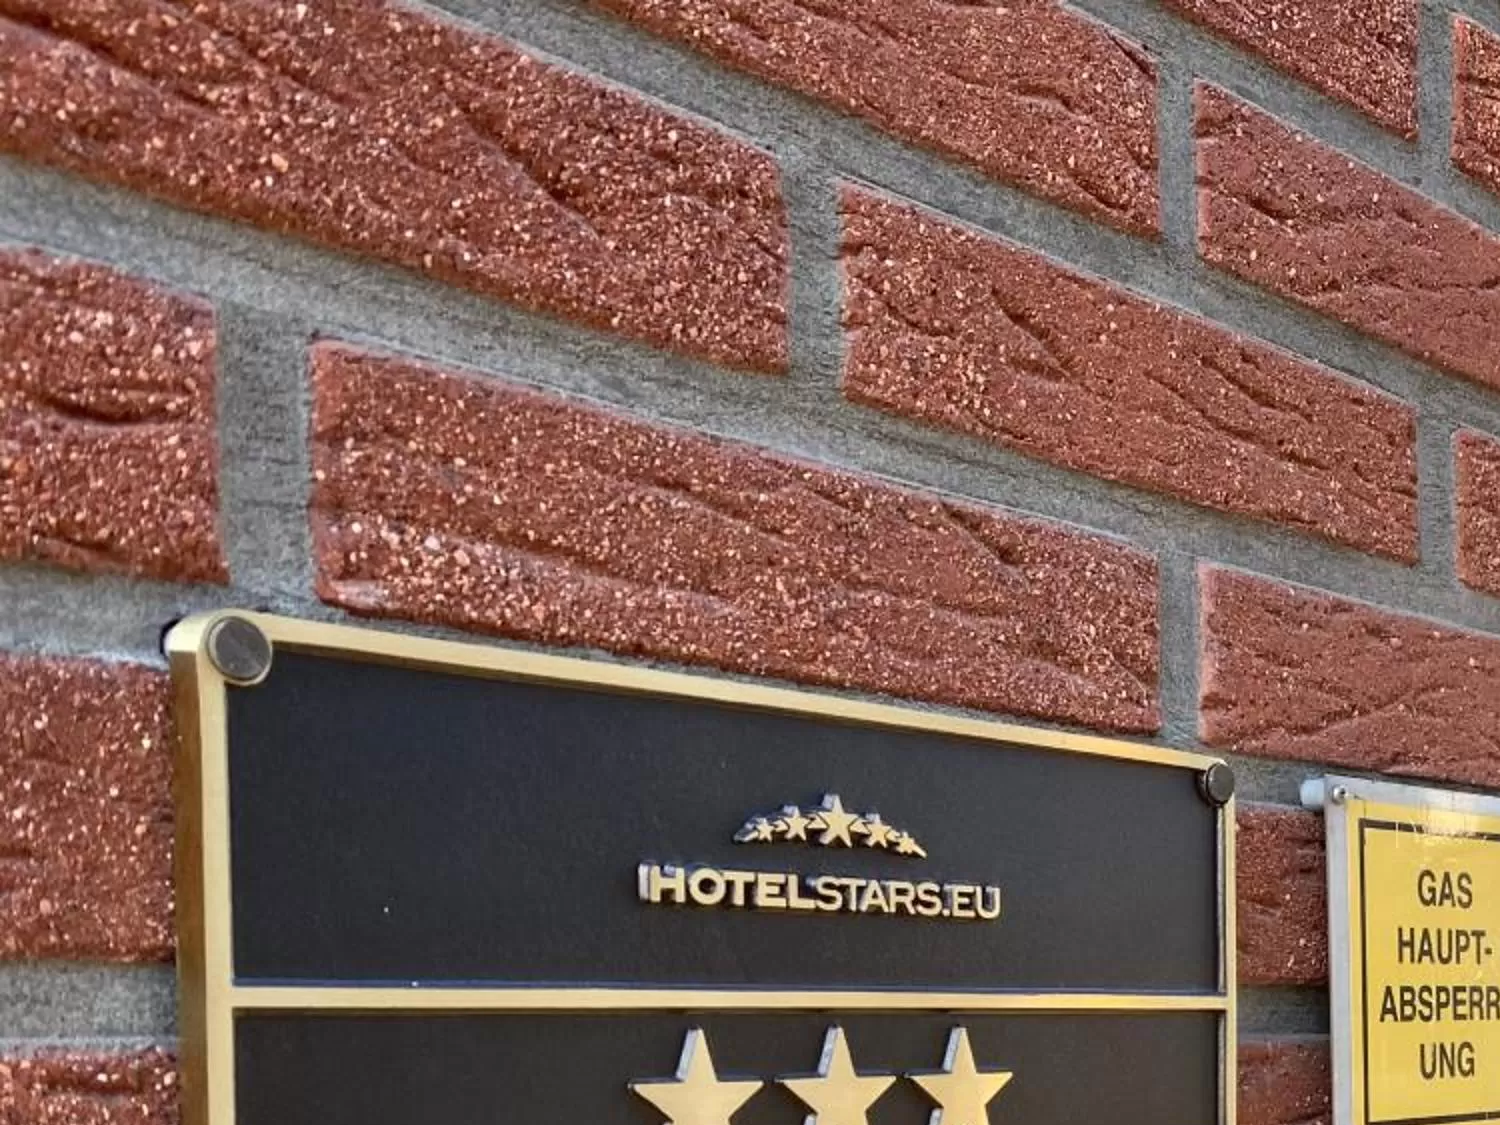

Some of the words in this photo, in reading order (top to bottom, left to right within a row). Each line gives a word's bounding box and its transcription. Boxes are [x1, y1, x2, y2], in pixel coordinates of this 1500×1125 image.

[639, 862, 1002, 920] HOTELSTARS.EU
[1417, 869, 1473, 909] GAS
[1397, 926, 1493, 965] HAUPT-
[1419, 1041, 1475, 1081] UNG
